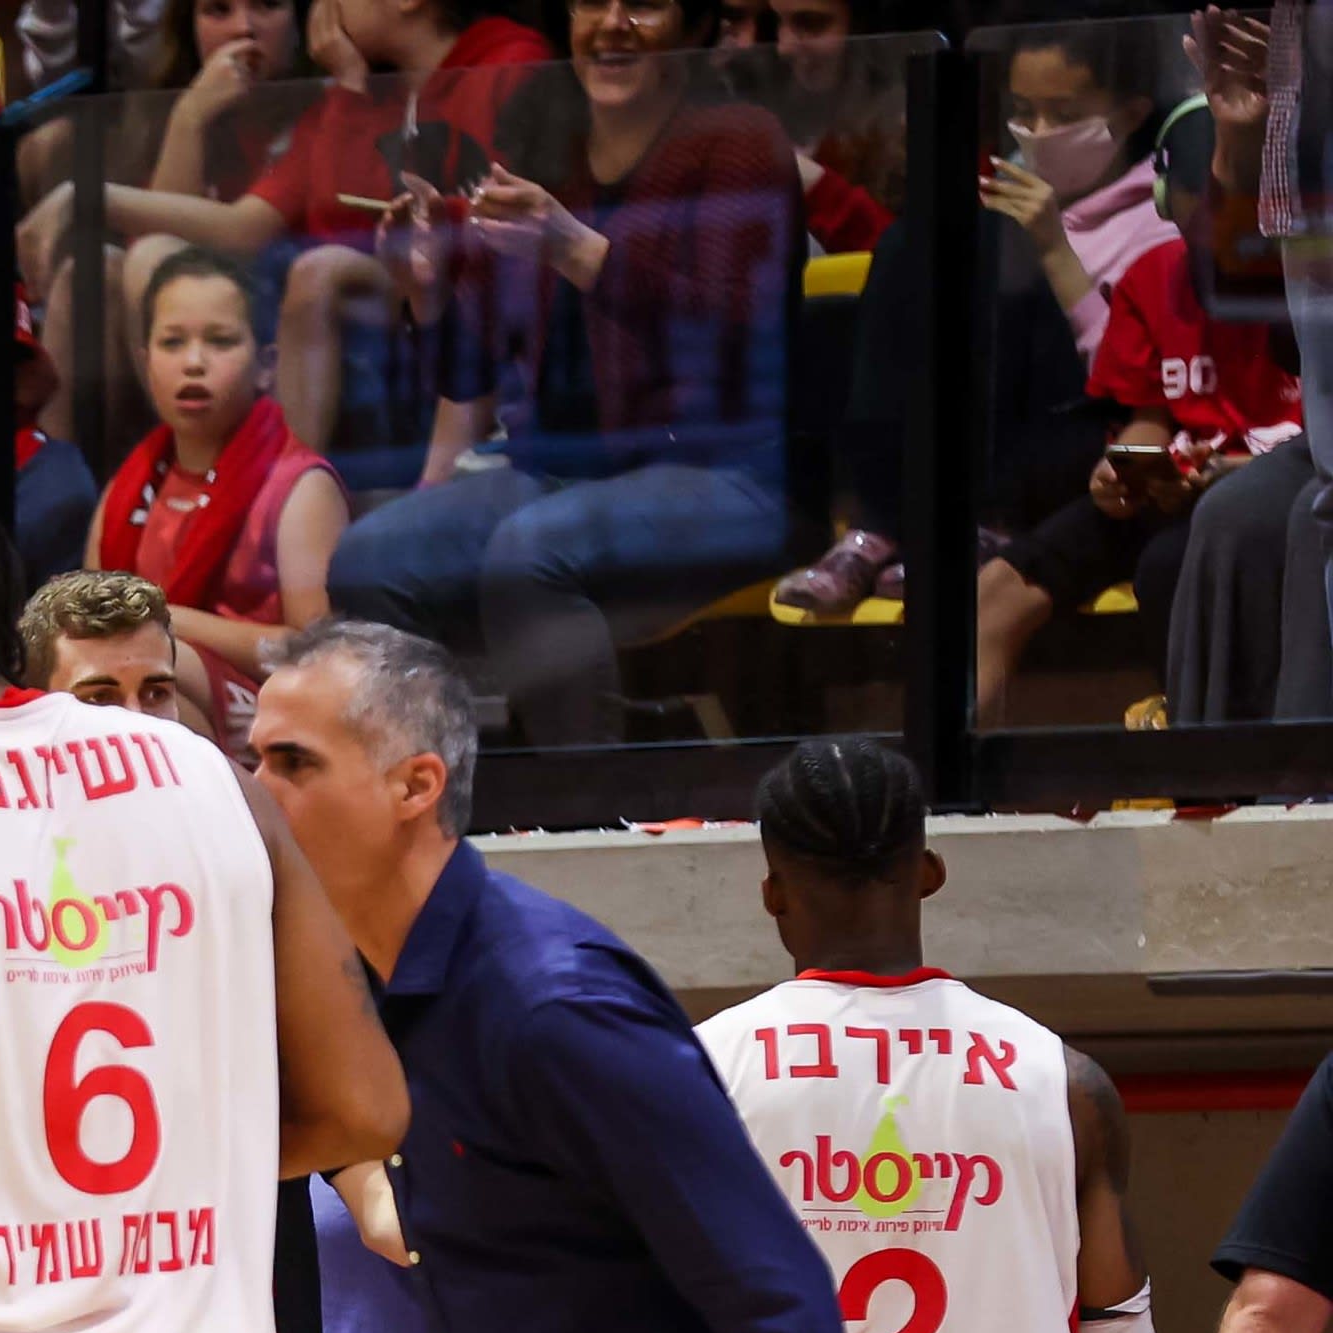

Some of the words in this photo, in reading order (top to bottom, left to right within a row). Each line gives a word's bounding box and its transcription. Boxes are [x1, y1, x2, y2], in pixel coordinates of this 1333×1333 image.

[1161, 355, 1217, 400] 90
[755, 1023, 1019, 1091] איירבו
[43, 1000, 162, 1195] 6
[779, 1135, 1004, 1231] מייסטר
[874, 1219, 910, 1233] פירות
